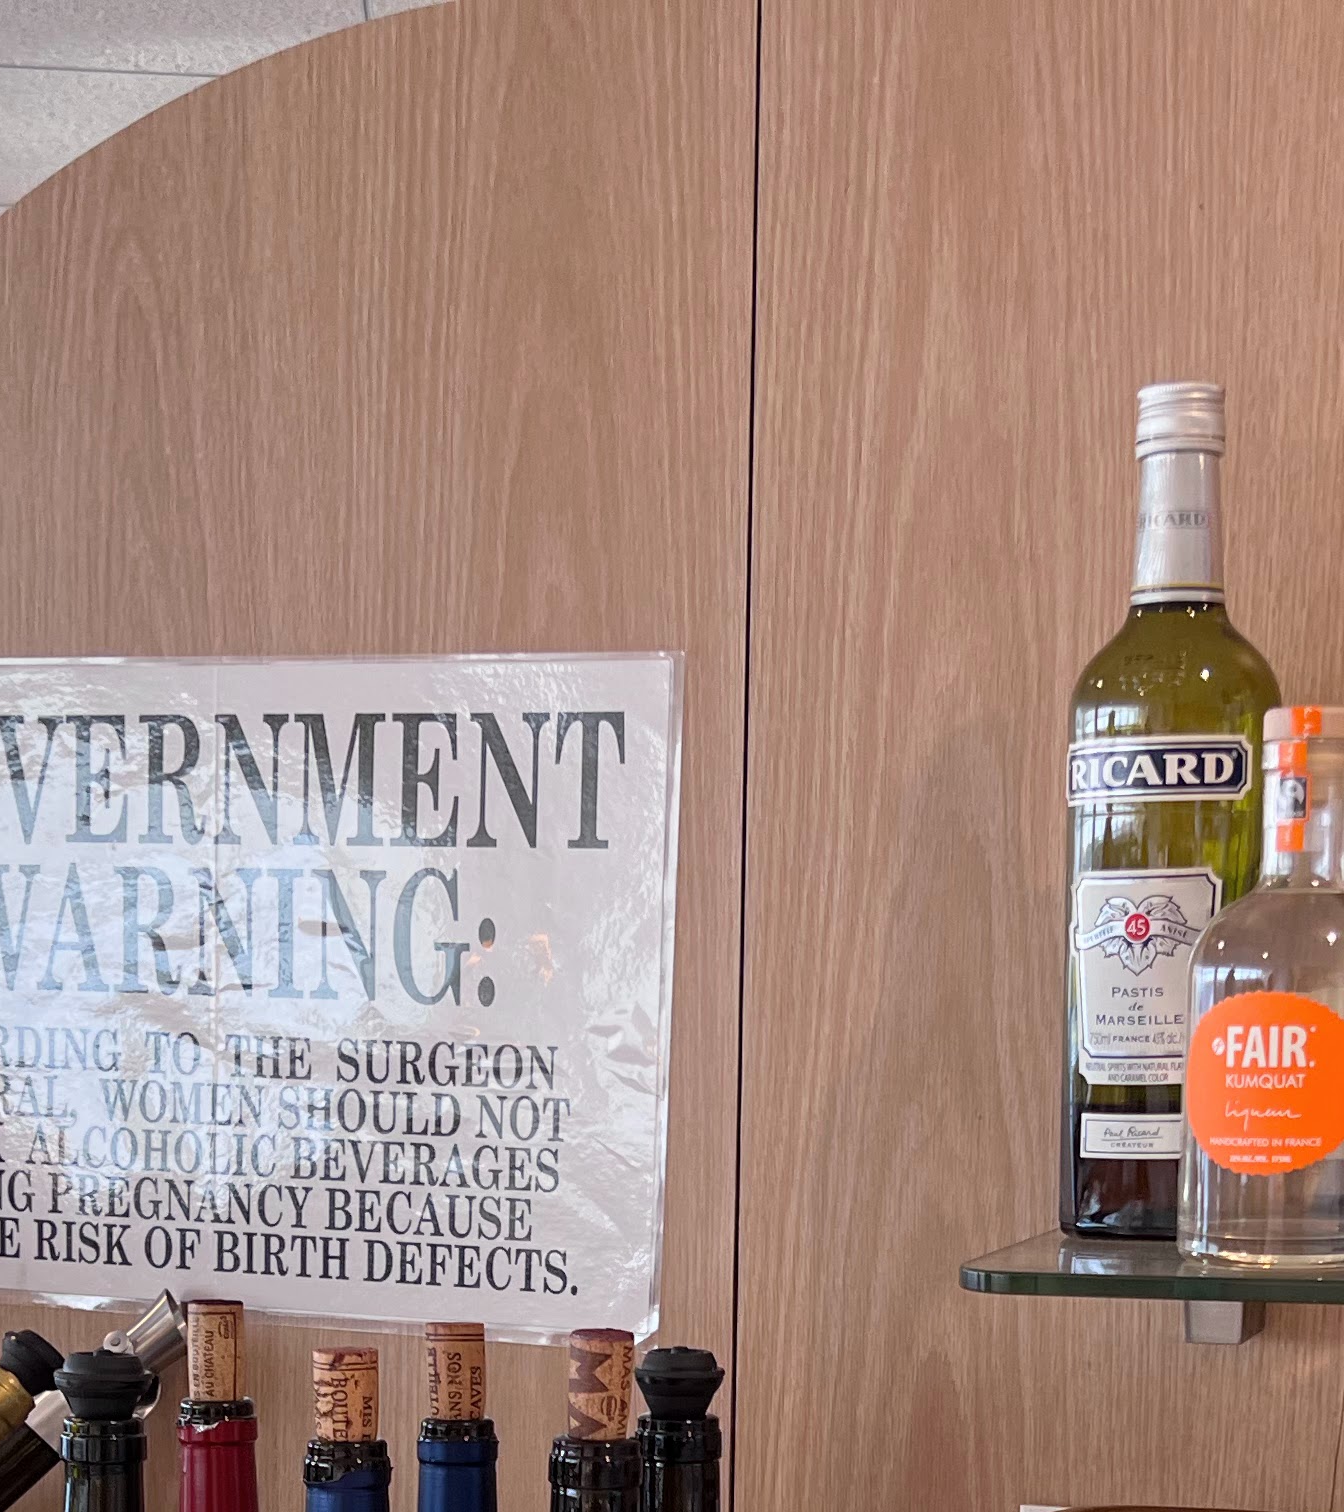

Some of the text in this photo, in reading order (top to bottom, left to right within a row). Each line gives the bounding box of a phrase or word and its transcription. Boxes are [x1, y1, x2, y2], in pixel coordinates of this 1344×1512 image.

[1138, 512, 1207, 530] RICARD
[1070, 752, 1235, 790] RICARD
[1126, 918, 1147, 936] 45
[1111, 987, 1164, 998] PASTIS
[1128, 1002, 1144, 1012] de
[1096, 1014, 1184, 1026] MARSEILLE
[1112, 1034, 1150, 1044] FRANCE
[146, 1031, 202, 1077] TO
[227, 1035, 313, 1081] THE
[336, 1038, 559, 1091] SURGEON
[1107, 1063, 1126, 1072] SPIRITS
[1127, 1063, 1142, 1072] WITH
[1143, 1063, 1169, 1072] NATURAL
[1107, 1073, 1169, 1082] AND CARAMEL COLOR
[1225, 1073, 1307, 1090] KUMQUAT
[101, 1078, 262, 1128] WOMEN
[276, 1085, 461, 1139] SHOULD
[474, 1096, 571, 1144] NOT
[1210, 1137, 1322, 1147] HANDCRAFTED IN FRANCE
[24, 1124, 277, 1179] ALCOHOLIC
[290, 1136, 561, 1194] BEVERAGES
[47, 1170, 311, 1231] PREGNANCY
[324, 1186, 534, 1243] BECAUSE
[33, 1224, 133, 1270] RISK
[142, 1229, 203, 1271] OF
[213, 1231, 353, 1282] BIRTH
[362, 1239, 580, 1297] DEFECTS.
[203, 1330, 215, 1397] AU CHATEAU
[621, 1346, 633, 1391] MAS
[362, 1396, 373, 1427] MIS
